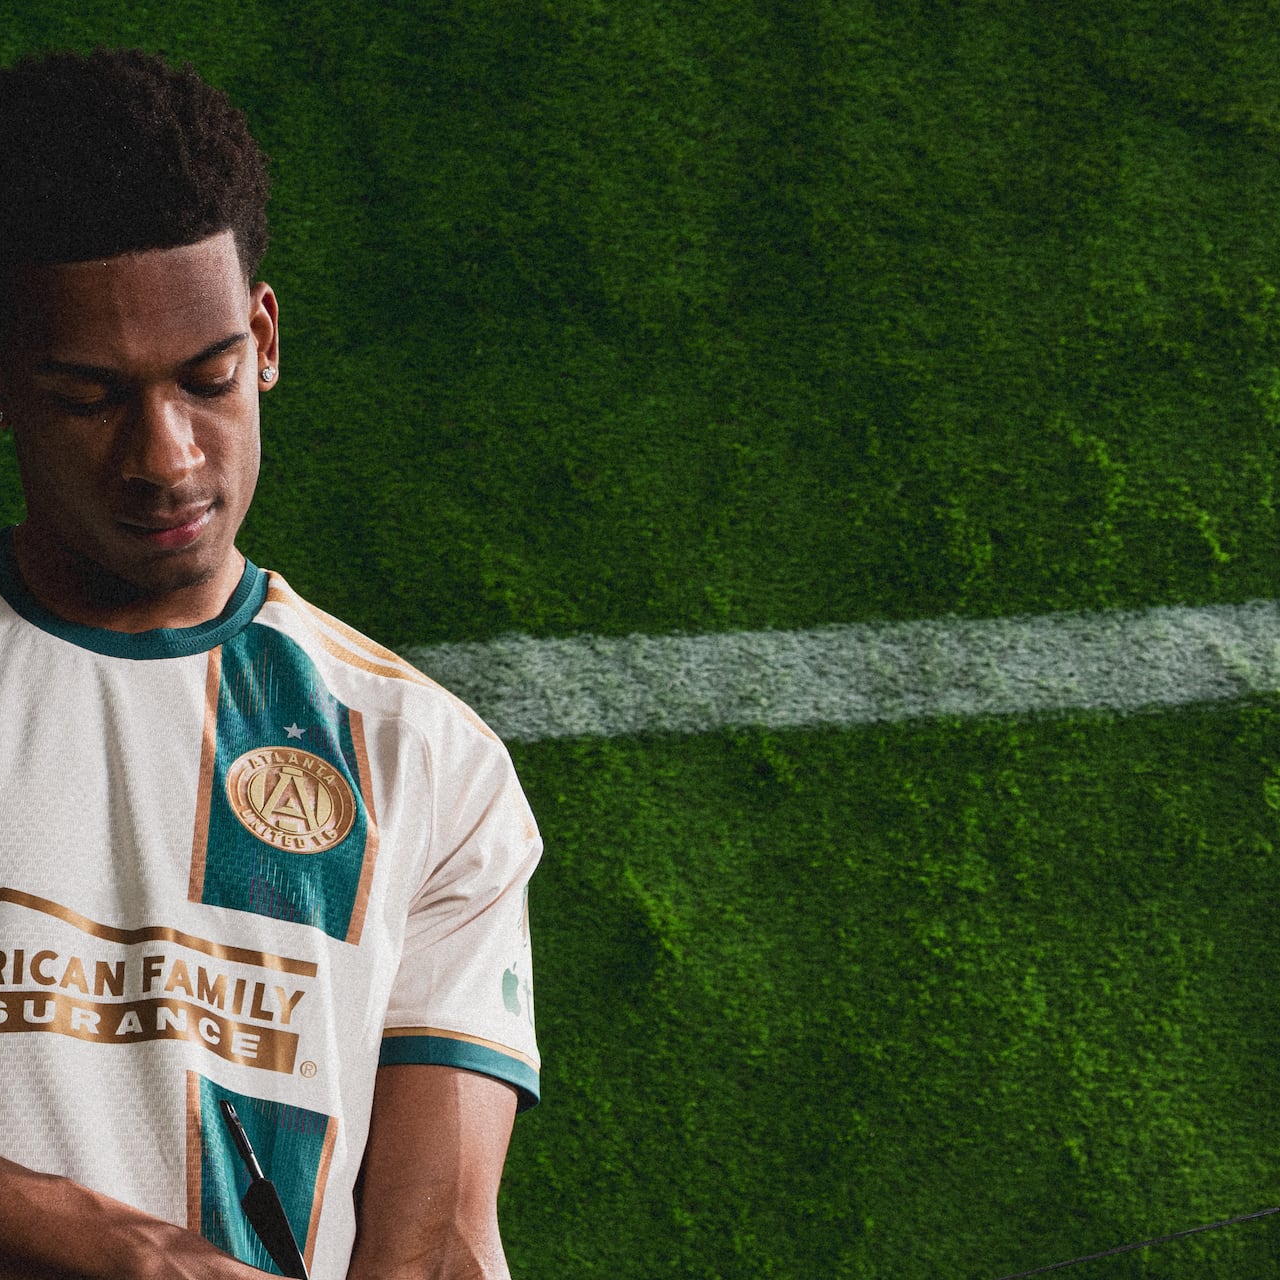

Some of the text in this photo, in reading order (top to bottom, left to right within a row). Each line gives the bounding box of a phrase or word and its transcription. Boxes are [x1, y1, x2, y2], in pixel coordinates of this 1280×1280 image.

[248, 751, 337, 785] ATLANTA
[240, 808, 308, 849] UNITED
[142, 954, 305, 1025] FAMILY
